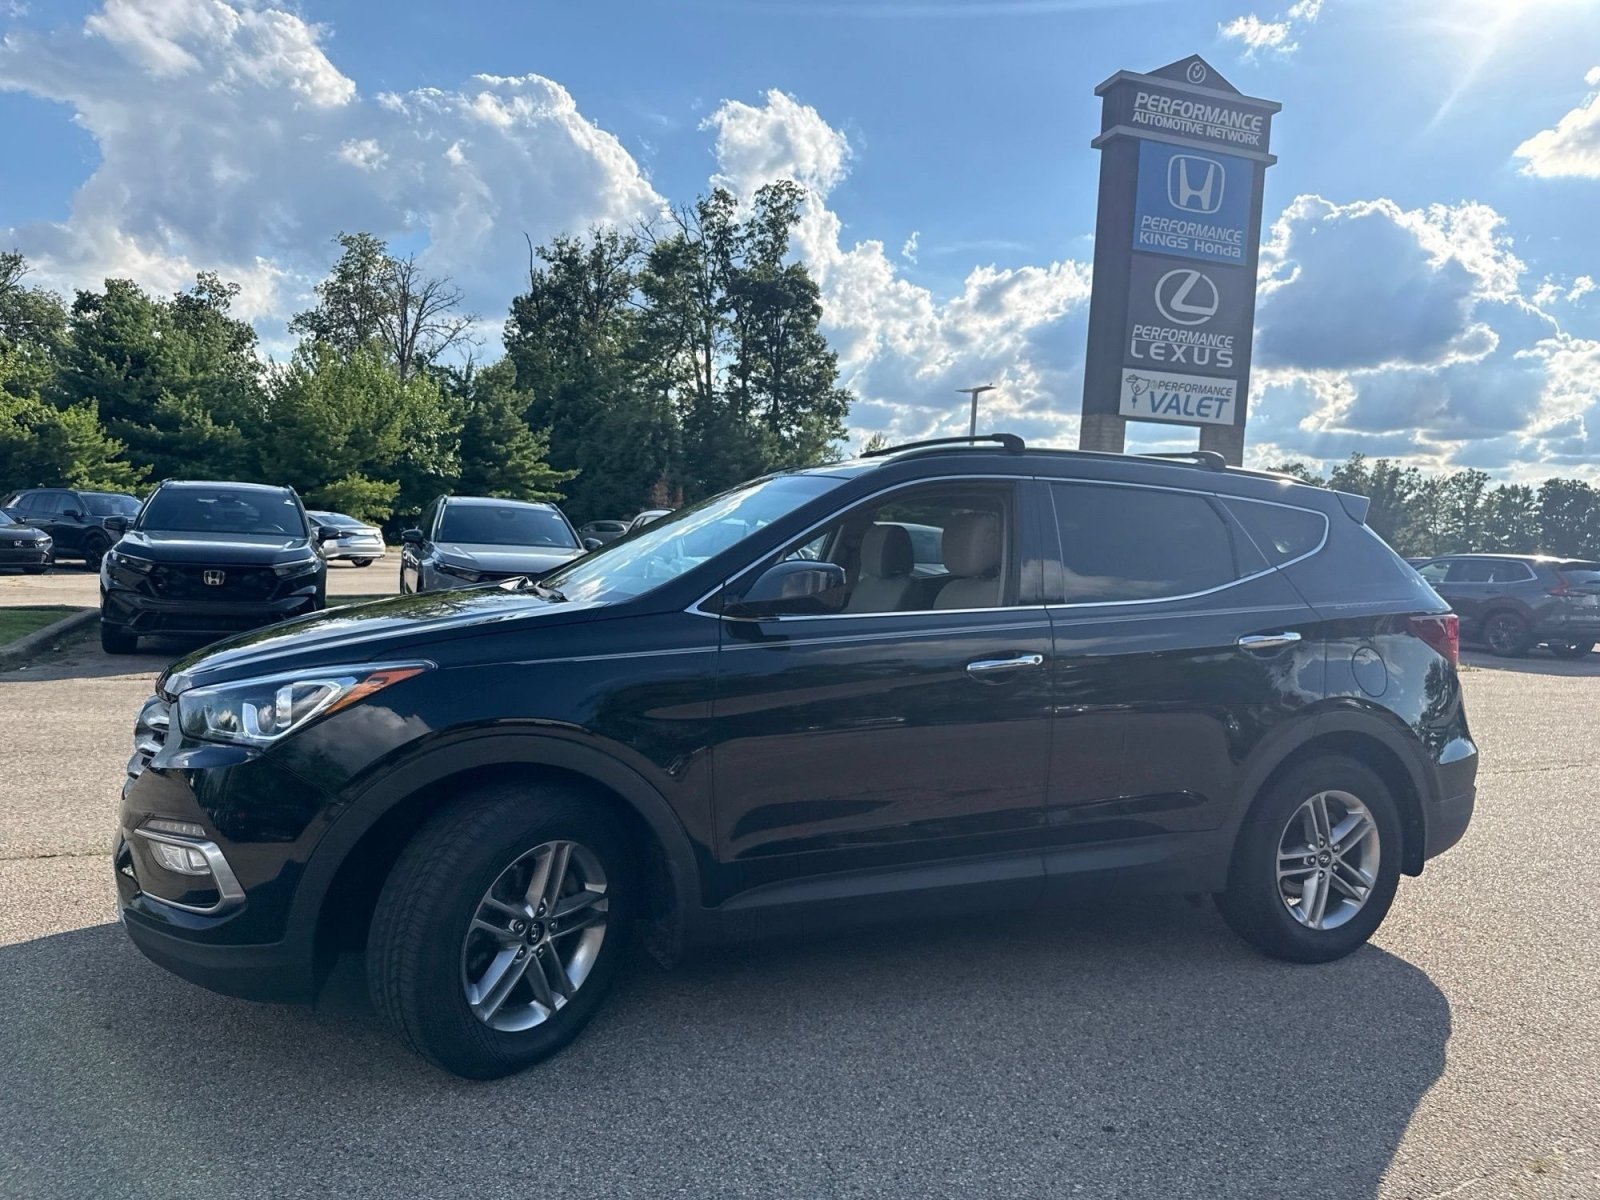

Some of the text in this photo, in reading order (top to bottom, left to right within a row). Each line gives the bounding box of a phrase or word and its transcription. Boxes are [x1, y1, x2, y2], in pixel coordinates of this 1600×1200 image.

[1134, 92, 1263, 132] PERFORMANCE
[1132, 111, 1260, 146] AUTOMOTIVE NETWORK
[1141, 215, 1243, 243] PERFORMANCE
[1139, 231, 1241, 258] KINGS Honda
[1132, 324, 1234, 349] PERFORMANCE
[1130, 340, 1233, 368] LEXUS
[1157, 380, 1233, 397] PERFORMANCE
[1150, 390, 1230, 419] VALET
